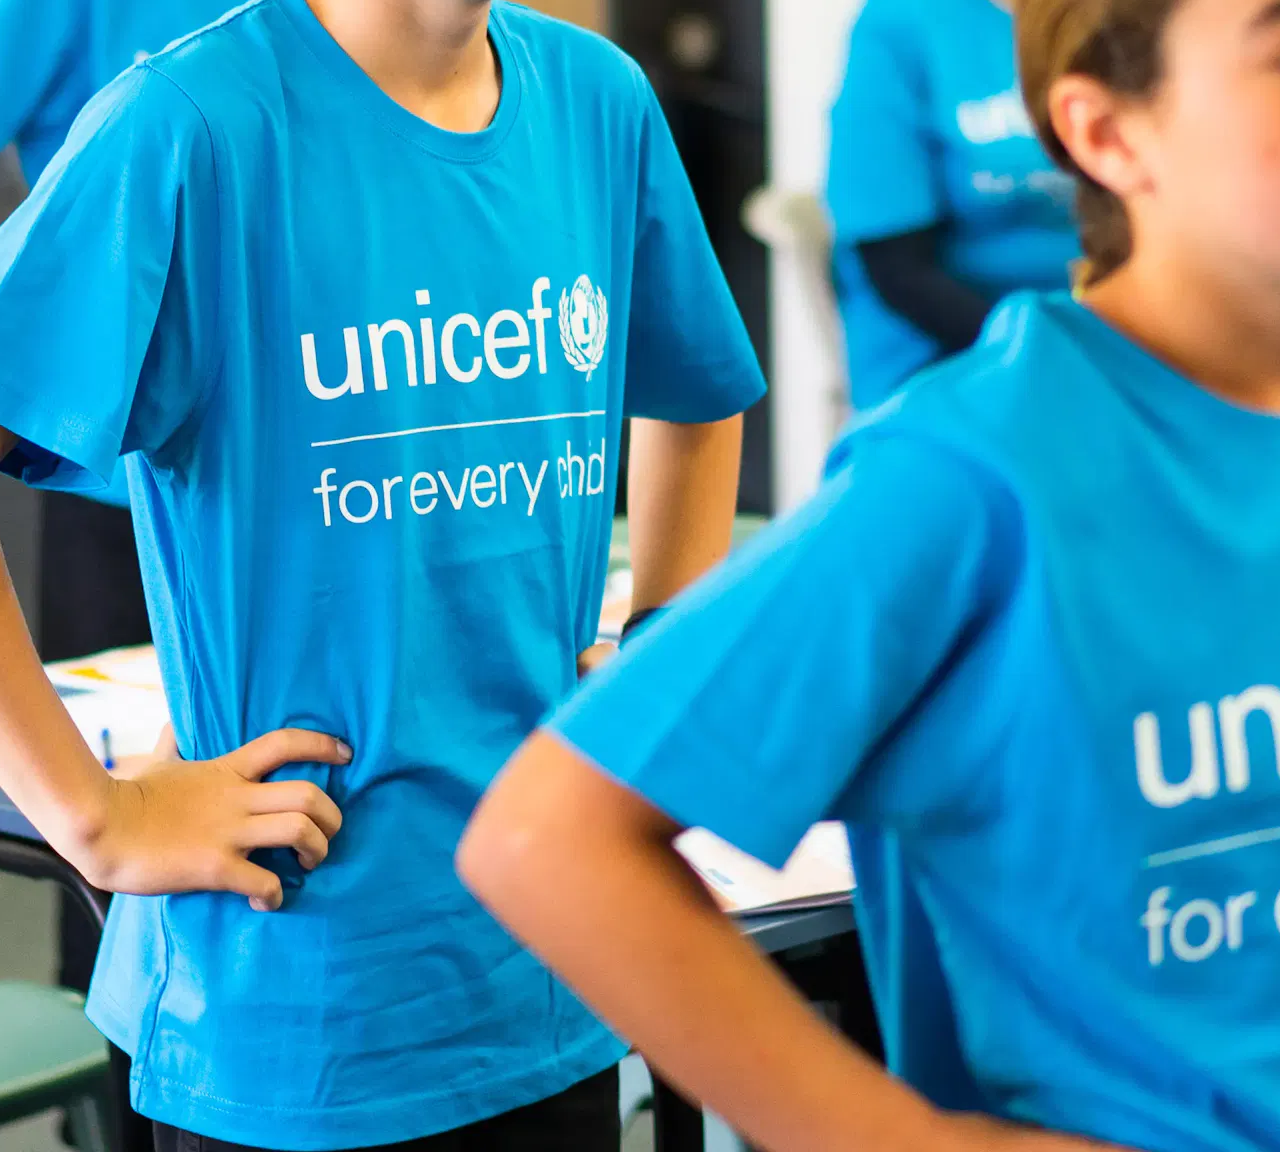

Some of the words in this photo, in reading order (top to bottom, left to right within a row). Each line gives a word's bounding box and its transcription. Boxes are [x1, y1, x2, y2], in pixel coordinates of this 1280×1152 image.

[300, 276, 552, 400] unicef
[313, 467, 404, 527] for
[409, 459, 549, 517] every
[1140, 884, 1258, 967] for
